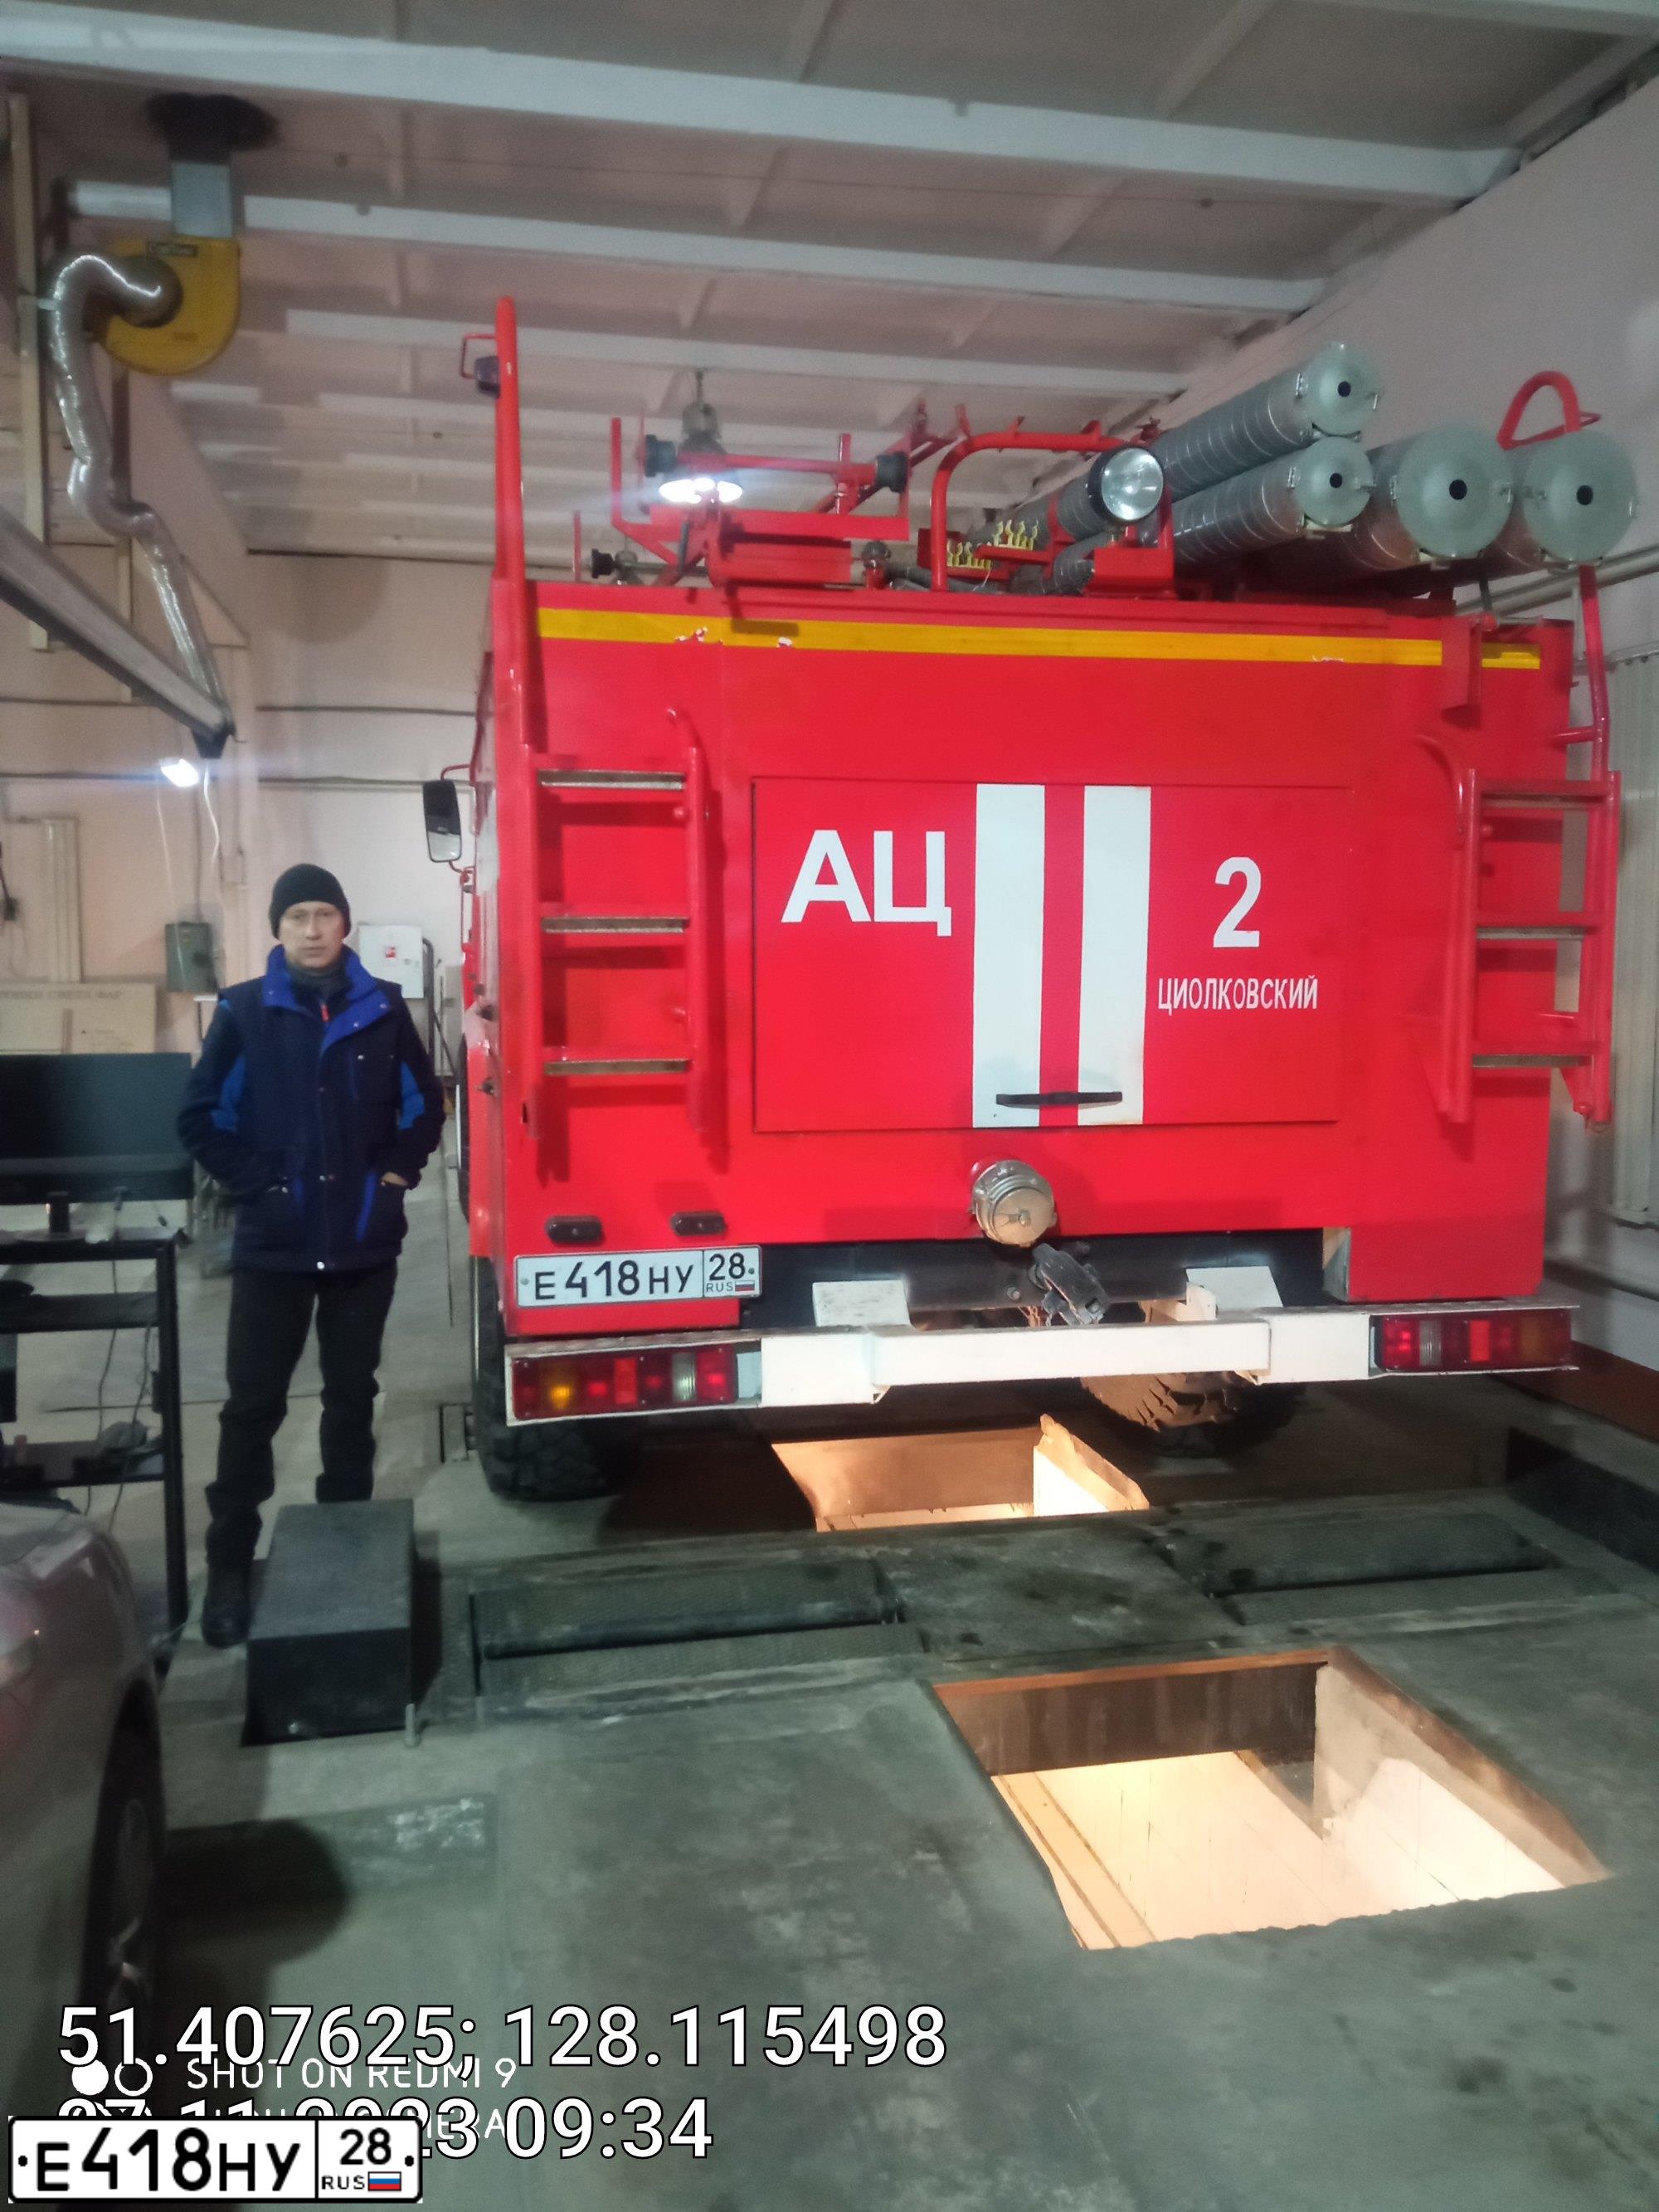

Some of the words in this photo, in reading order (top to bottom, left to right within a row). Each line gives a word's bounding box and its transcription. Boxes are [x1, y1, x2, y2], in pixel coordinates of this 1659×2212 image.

[781, 830, 952, 937] АЦ
[1213, 856, 1262, 948] 2
[1158, 974, 1318, 1016] ЦИОЛКОВСКИЙ
[706, 1281, 734, 1293] RUS
[708, 1252, 746, 1281] 28
